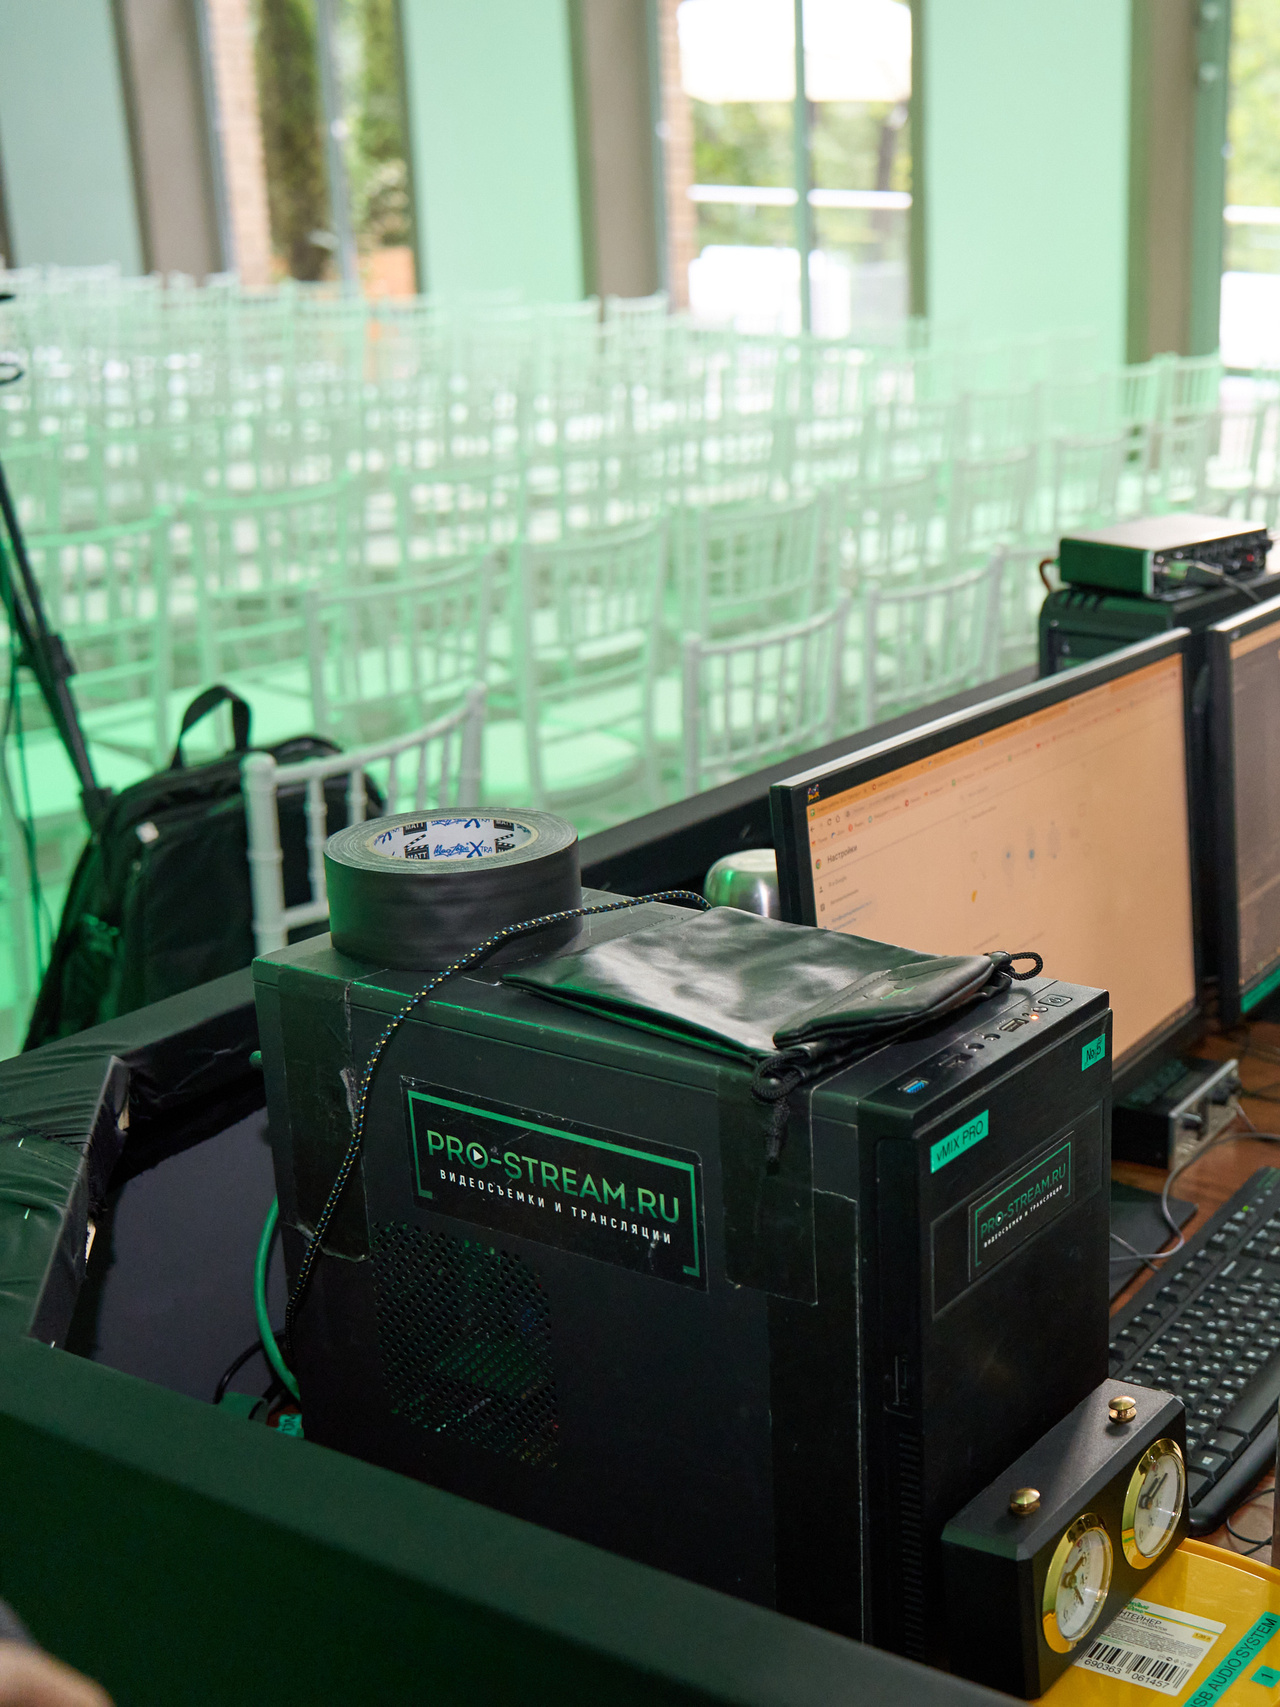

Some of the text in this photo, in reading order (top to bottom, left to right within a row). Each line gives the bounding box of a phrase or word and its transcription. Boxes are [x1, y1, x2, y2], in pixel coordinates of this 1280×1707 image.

[827, 845, 858, 864] Настройки
[936, 1120, 984, 1162] vMIX PRO
[427, 1129, 680, 1223] PRO-STREAM.RU
[440, 1169, 671, 1244] ВИДЕОСЪЕМКИ И ТРАНСЛЯЦИИ
[980, 1163, 1066, 1239] PRO-STREAM.RU
[1120, 1610, 1162, 1625] НТЕЙНЕР
[1084, 1659, 1170, 1689] 690363 061457
[1208, 1658, 1241, 1692] AUDIO
[1236, 1618, 1278, 1658] SYSTEM
[1261, 1672, 1274, 1680] 1
